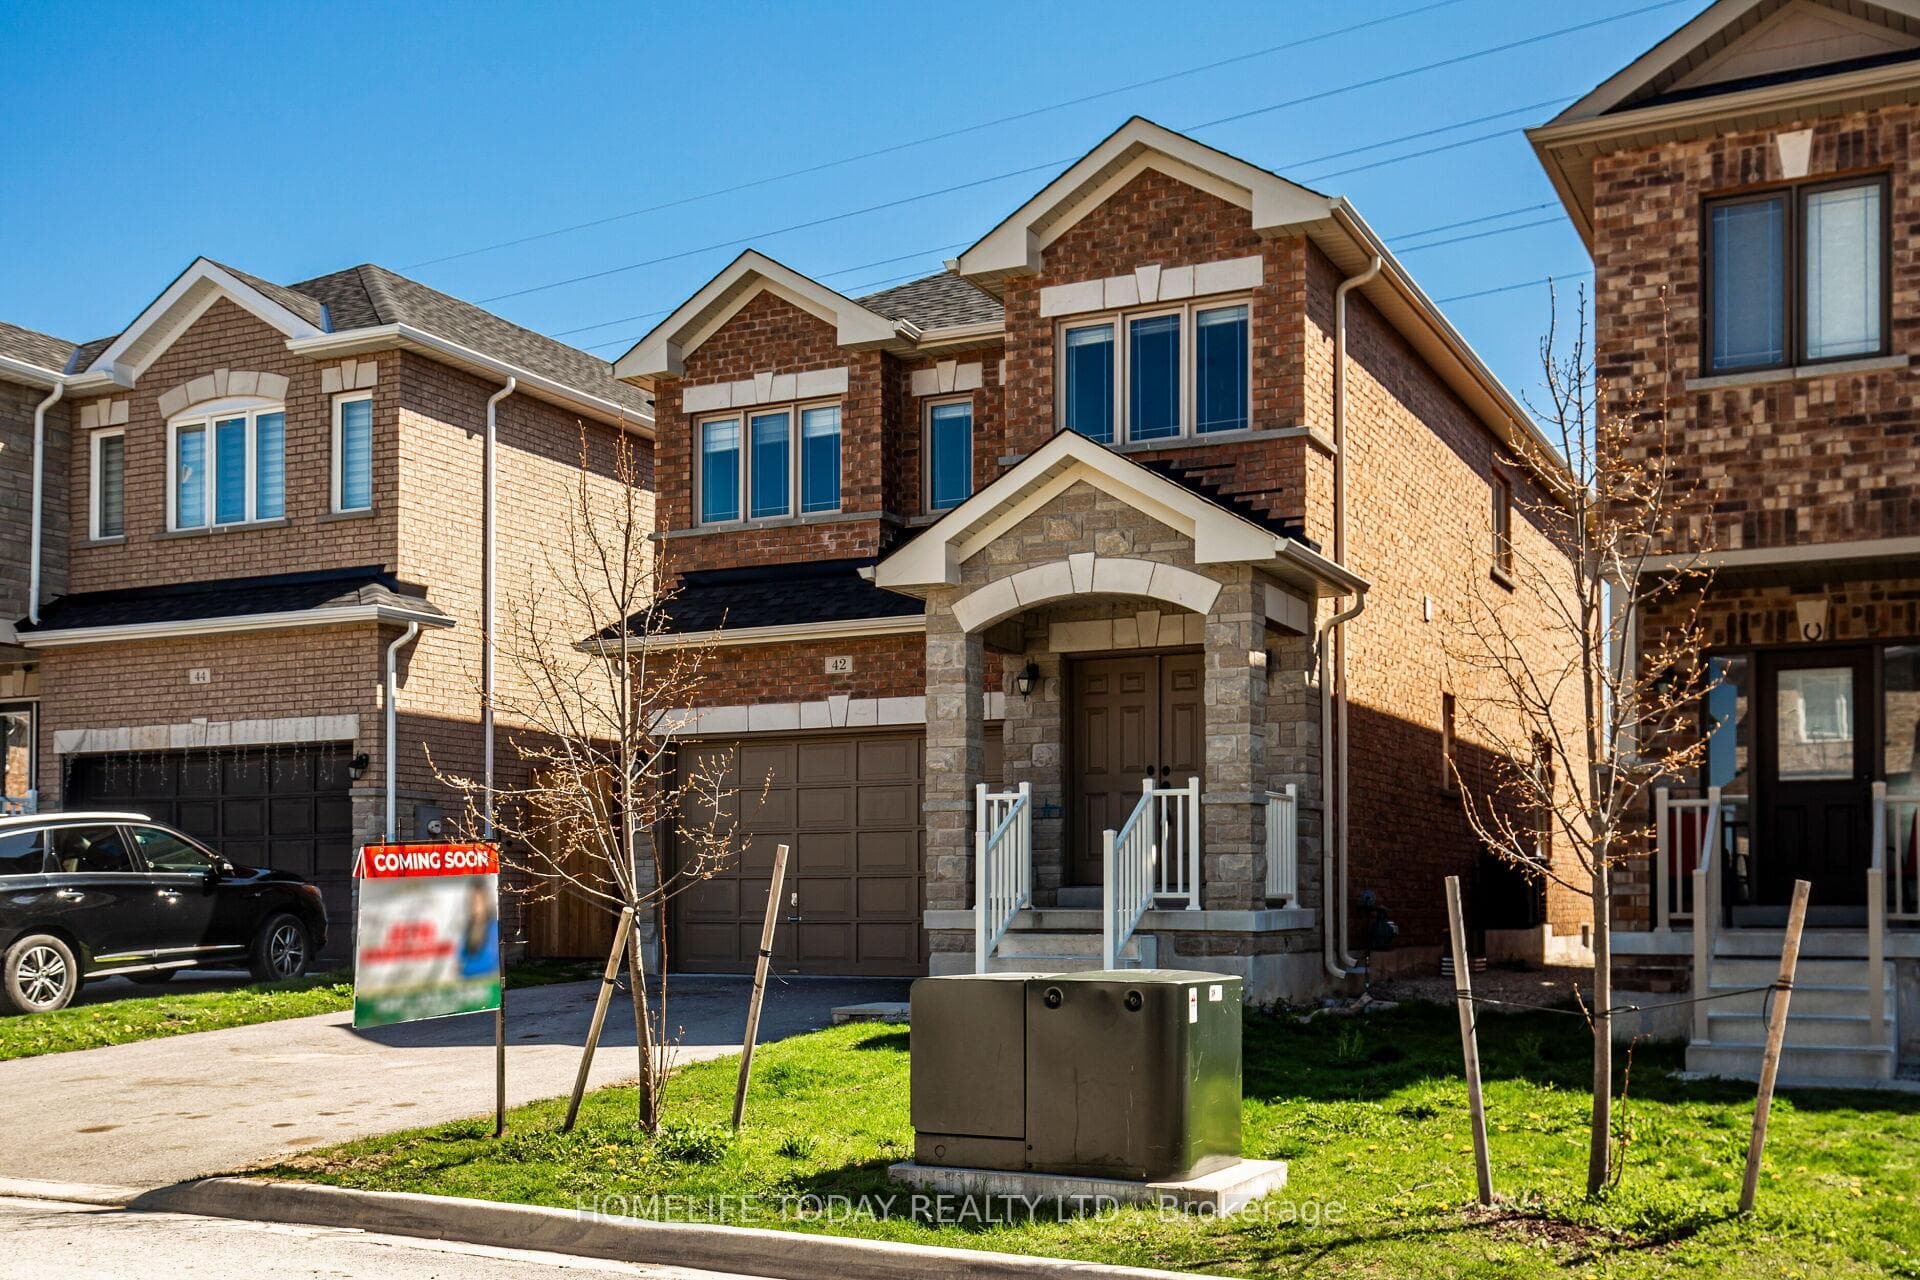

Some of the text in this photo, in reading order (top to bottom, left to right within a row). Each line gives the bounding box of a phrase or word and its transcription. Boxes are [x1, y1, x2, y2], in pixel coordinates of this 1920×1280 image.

[831, 658, 847, 670] 42
[194, 671, 206, 681] 44
[374, 850, 489, 872] COMING SOON
